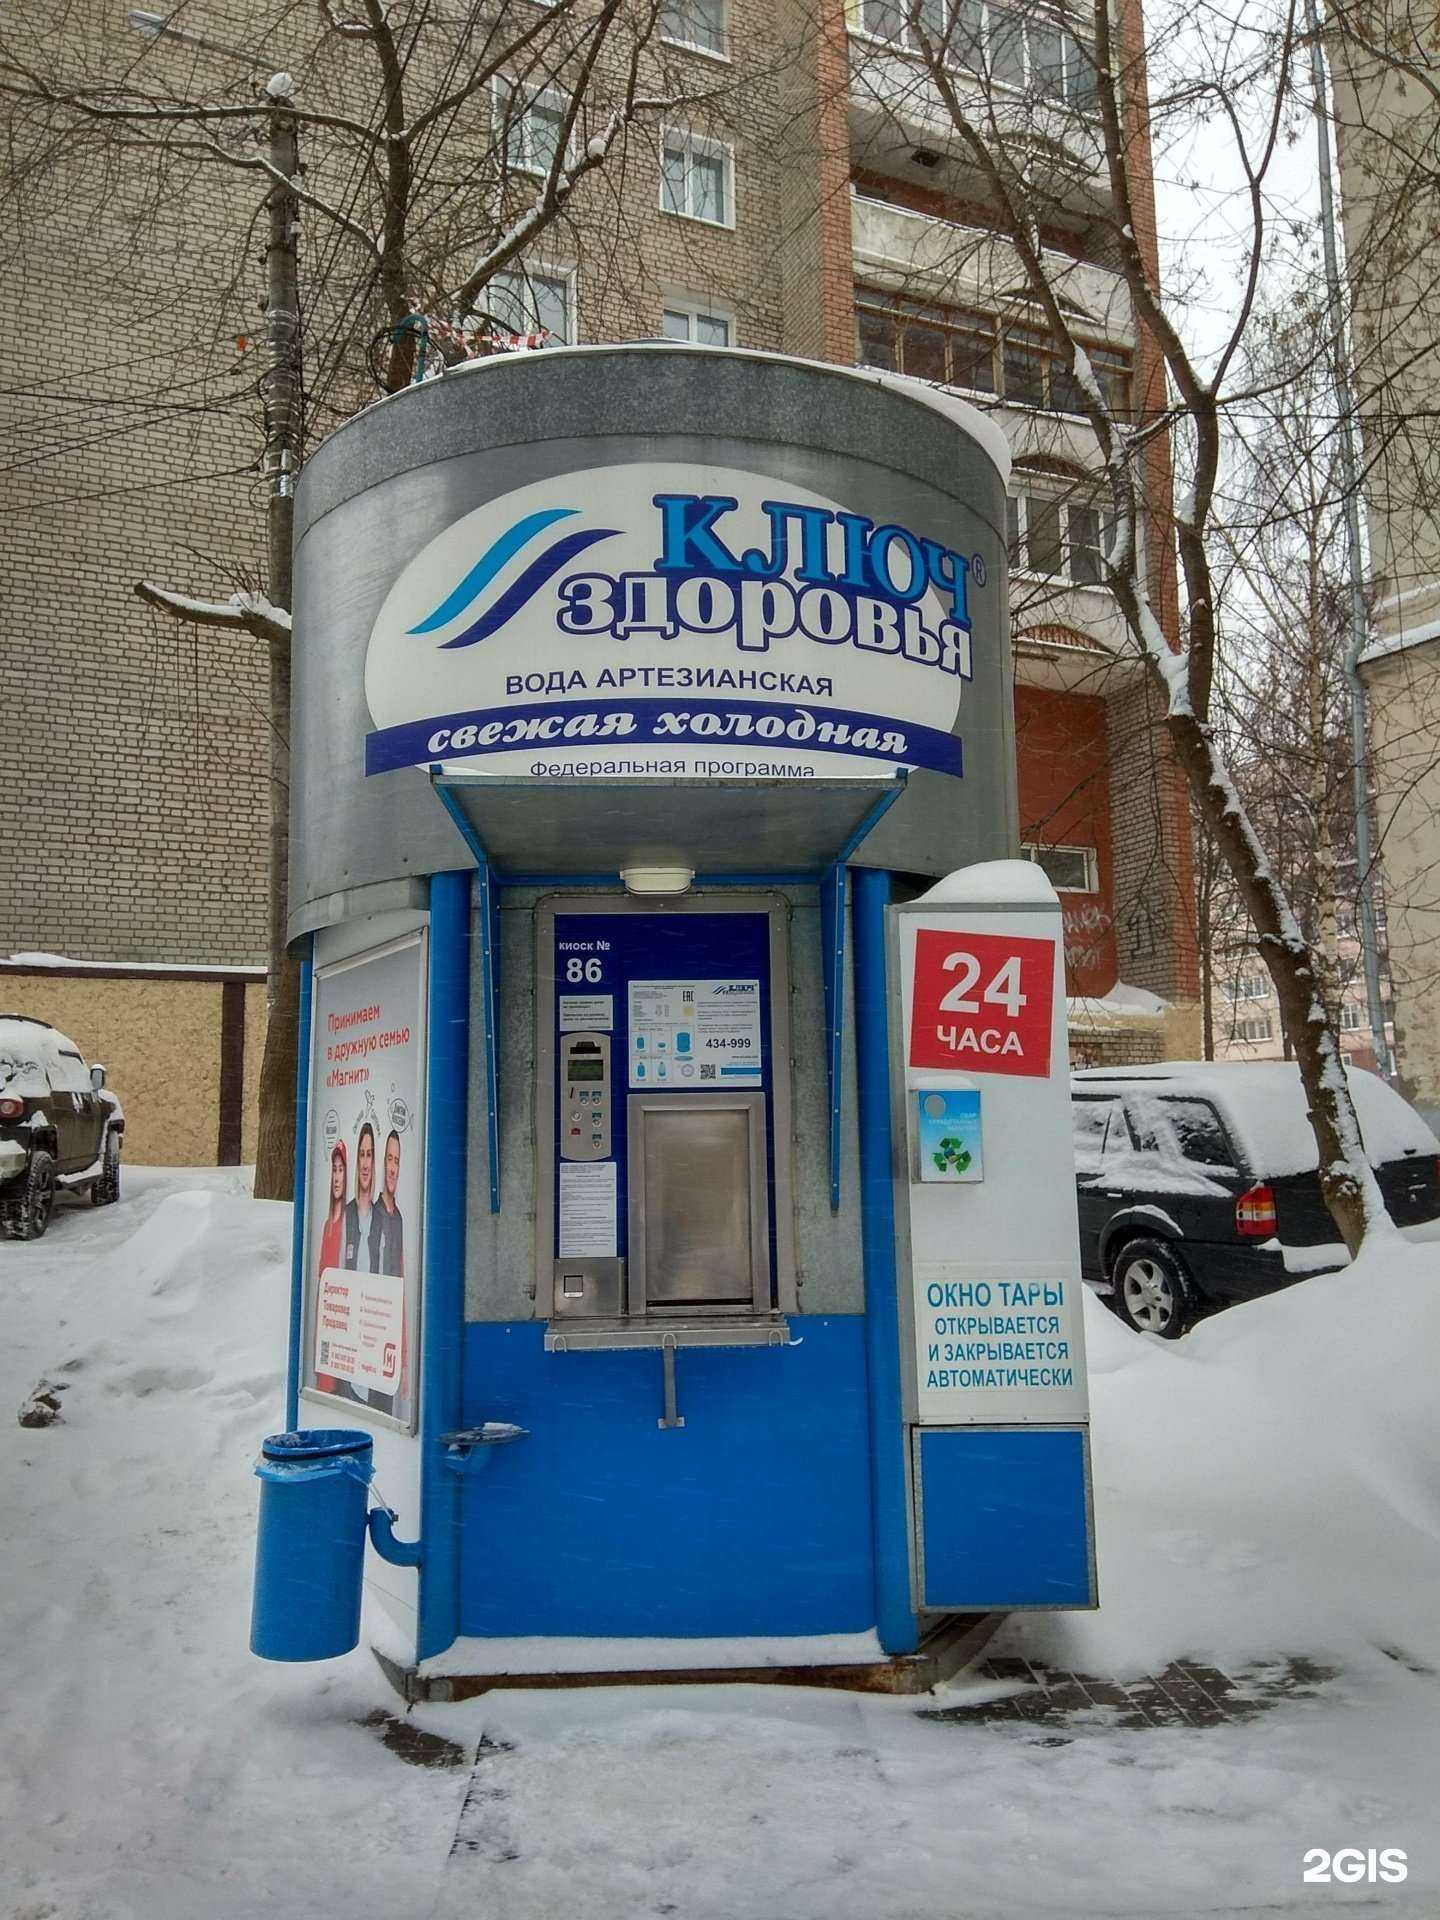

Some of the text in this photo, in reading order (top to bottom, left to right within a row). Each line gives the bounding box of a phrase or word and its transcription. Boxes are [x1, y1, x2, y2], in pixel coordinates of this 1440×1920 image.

[653, 494, 972, 625] КЛЮЧ
[506, 667, 834, 697] ВОДА АРТЕЗИАНСКАЯ
[427, 708, 909, 755] свежая холодная
[530, 759, 816, 777] Федеральная программа
[566, 957, 602, 983] 86
[938, 952, 1027, 1018] 24
[328, 1004, 380, 1035] Принимаем
[327, 1027, 410, 1062] в дружную семью
[705, 1038, 751, 1049] 434-999
[936, 1025, 1025, 1056] ЧАСА
[326, 1066, 369, 1088] «Магнит»
[926, 1282, 1064, 1307] ОКНО ТАРЫ
[934, 1316, 1059, 1335] ОТКРЫВАЕТСЯ
[928, 1341, 1069, 1361] И ЗАКРЫВАЕТСЯ
[926, 1366, 1073, 1388] АВТОМАТИЧЕСКИ
